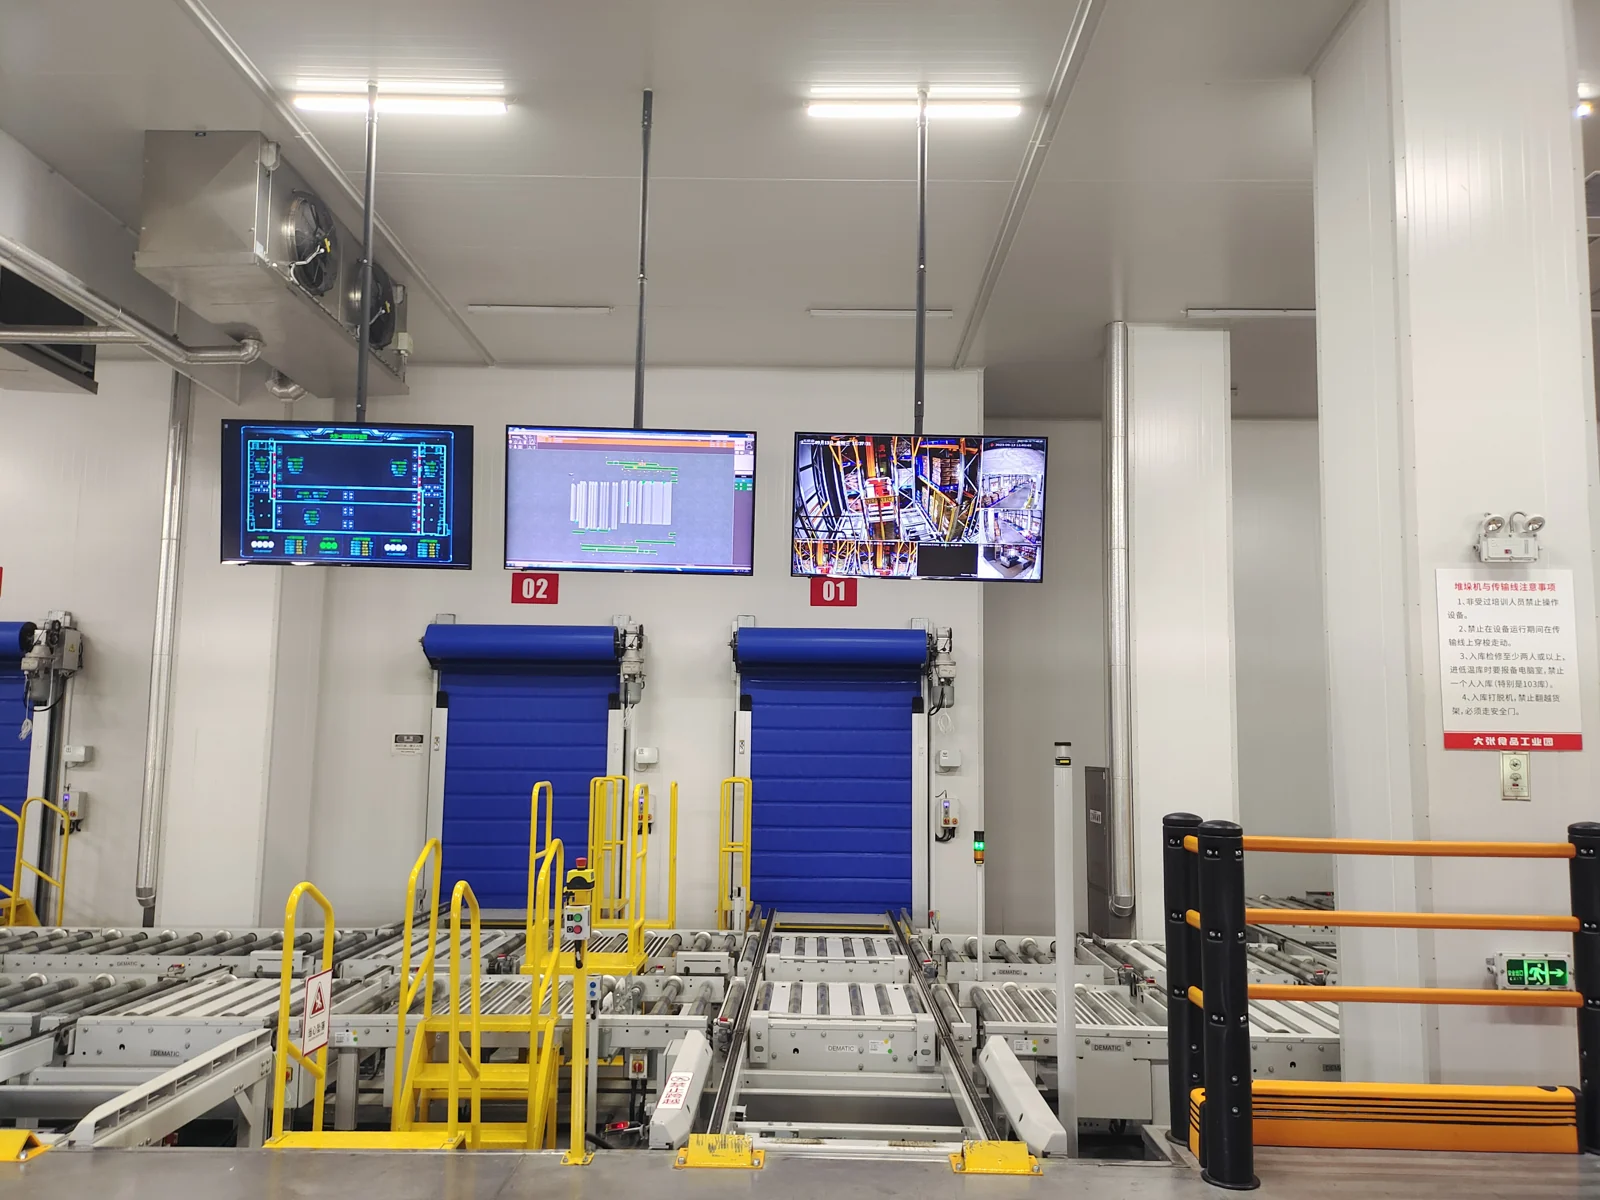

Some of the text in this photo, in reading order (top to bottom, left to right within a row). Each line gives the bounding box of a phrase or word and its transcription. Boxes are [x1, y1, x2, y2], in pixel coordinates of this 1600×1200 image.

[521, 578, 548, 599] 02
[822, 580, 846, 602] 01
[1454, 582, 1556, 592] 堆垛机与传输线注意事项
[1457, 597, 1559, 606] 1、非受过培训人员禁止操作
[1448, 611, 1468, 619] 设备。
[1458, 625, 1560, 634] 2、禁止在设备运行期间在传
[1448, 638, 1512, 647] 输线上穿梭走动。
[1473, 736, 1554, 747] 大张食品工业园
[1094, 1044, 1121, 1052] DEMATIC
